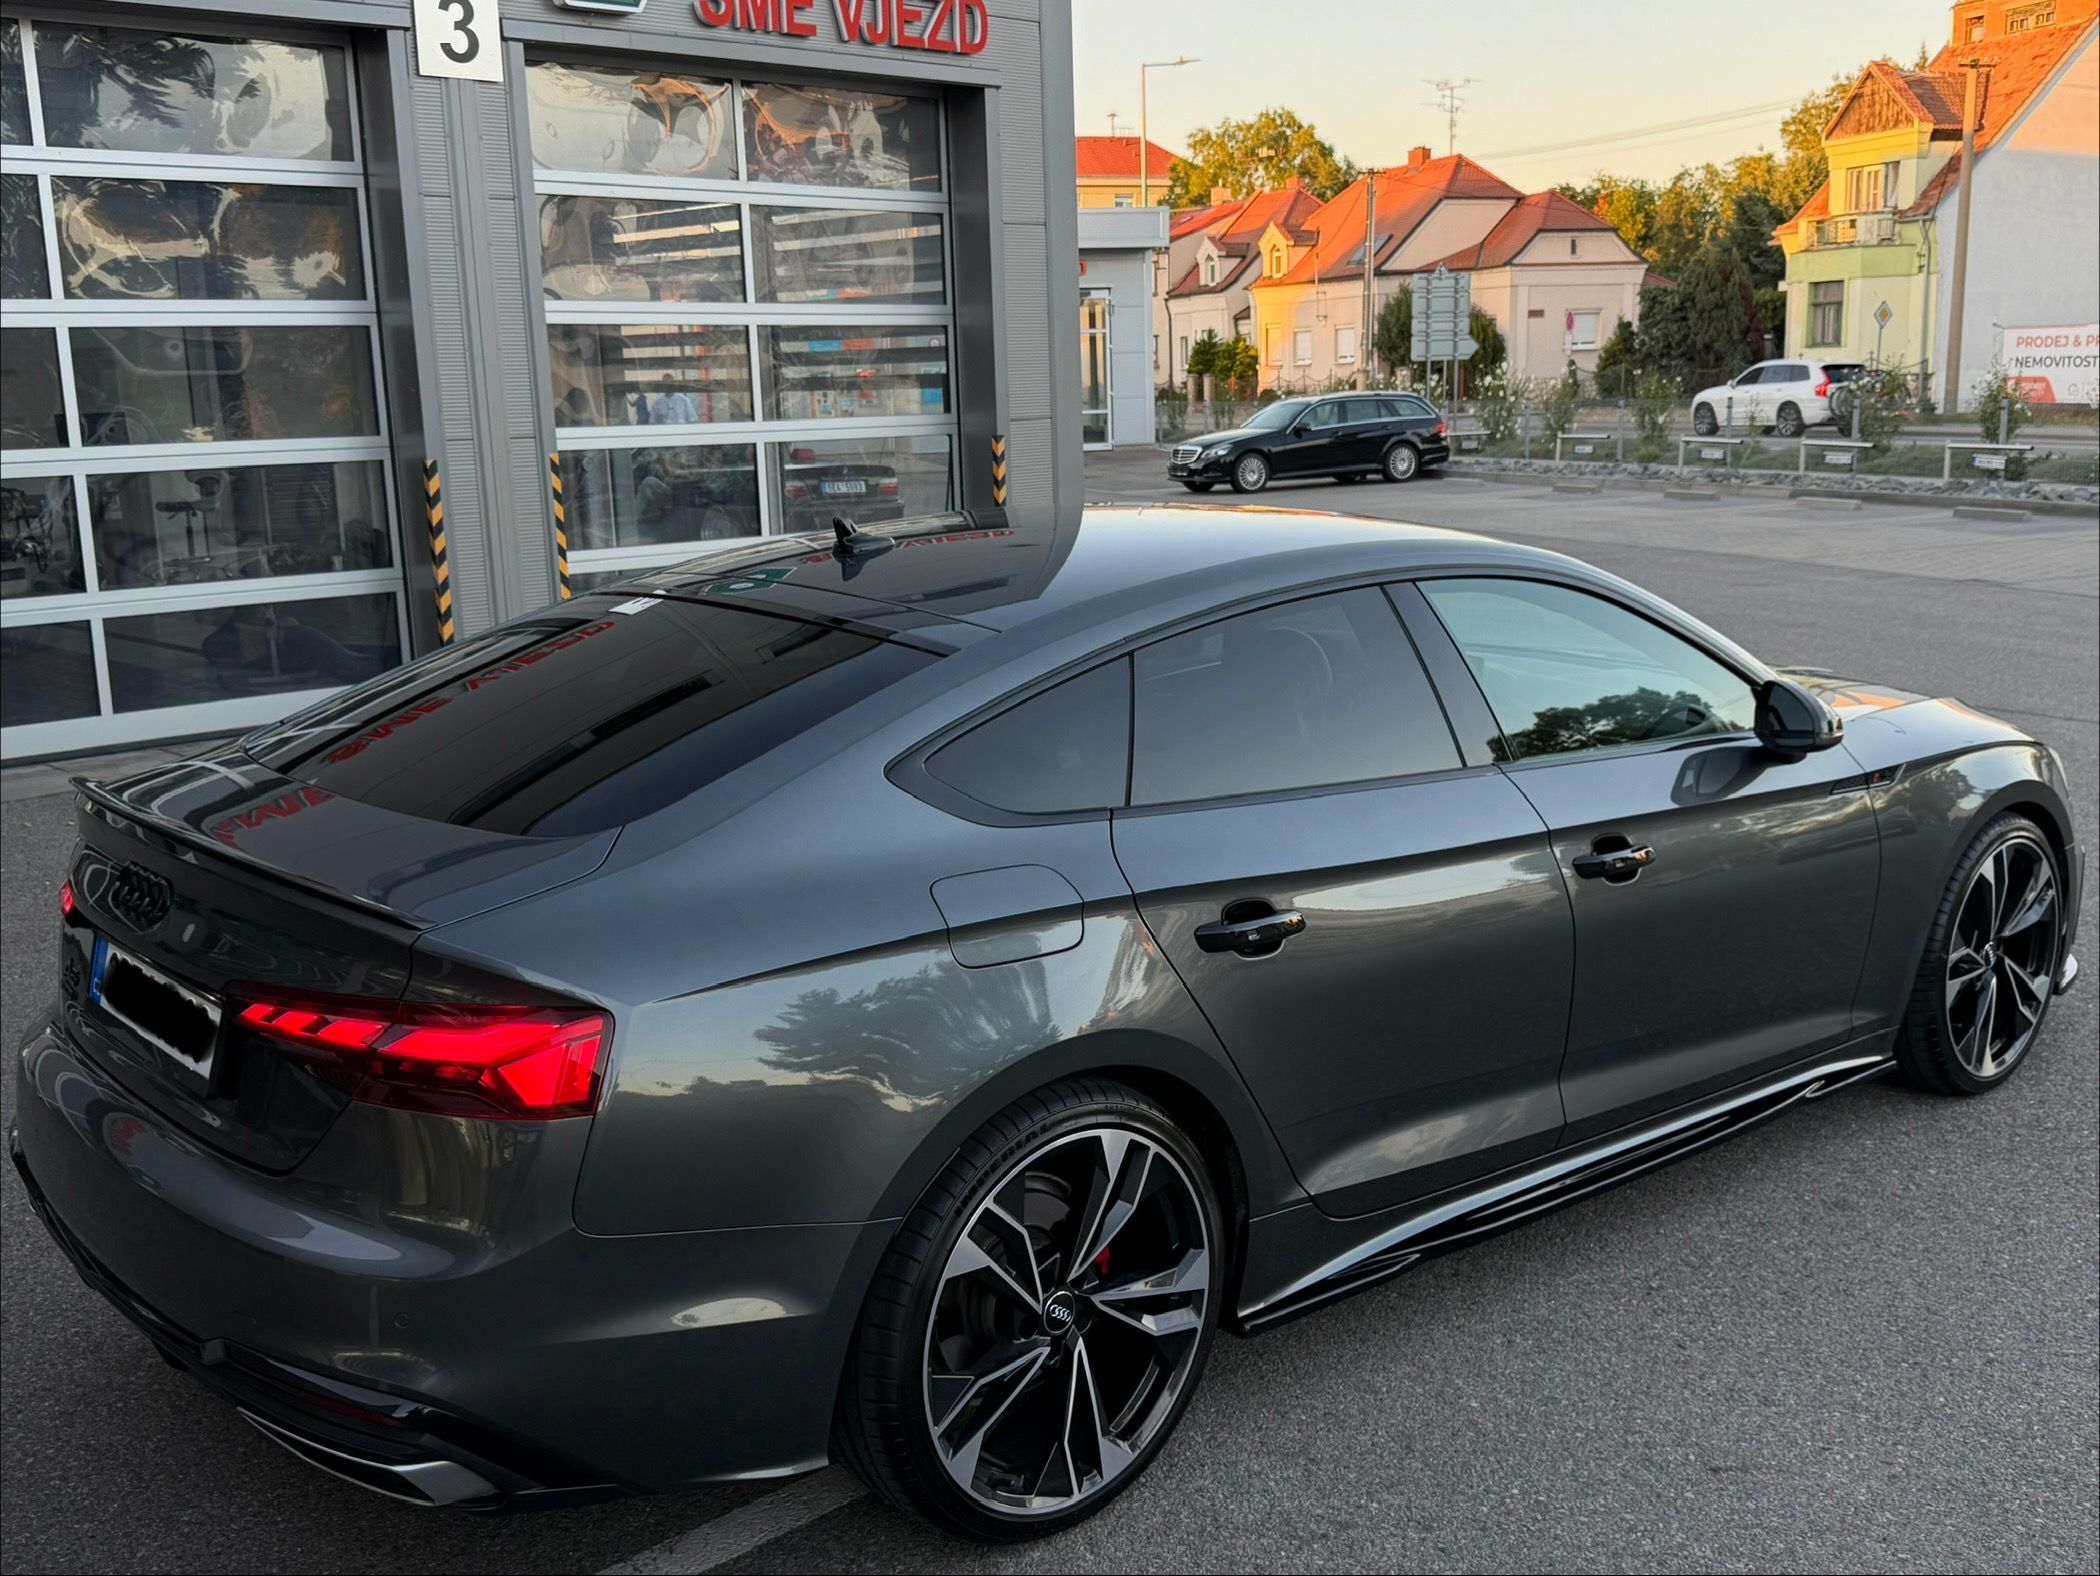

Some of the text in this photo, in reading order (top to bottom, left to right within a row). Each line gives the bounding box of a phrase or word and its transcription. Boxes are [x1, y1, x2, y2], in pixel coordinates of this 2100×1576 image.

[438, 0, 480, 64] 3
[833, 0, 988, 54] VJEZD
[2016, 335, 2069, 348] PRODEJ
[2073, 335, 2082, 347] &
[2014, 356, 2099, 368] NEMOVITOST
